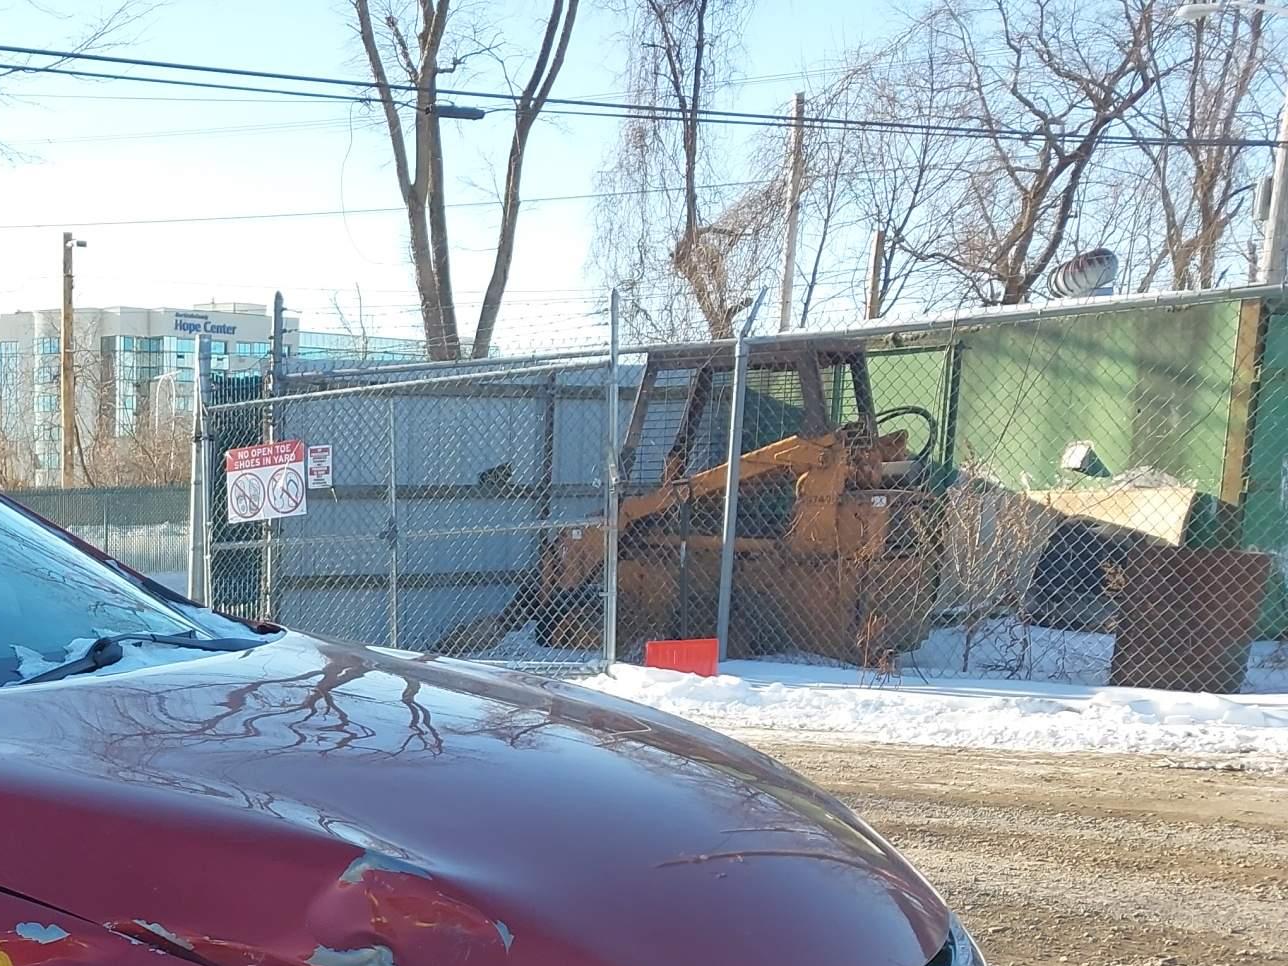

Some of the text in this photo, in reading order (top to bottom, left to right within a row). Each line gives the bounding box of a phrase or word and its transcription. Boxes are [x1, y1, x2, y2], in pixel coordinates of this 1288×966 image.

[174, 319, 237, 335] Hope Center
[238, 444, 291, 459] NO OPEN TOE
[234, 453, 296, 470] SHOES IN YARD
